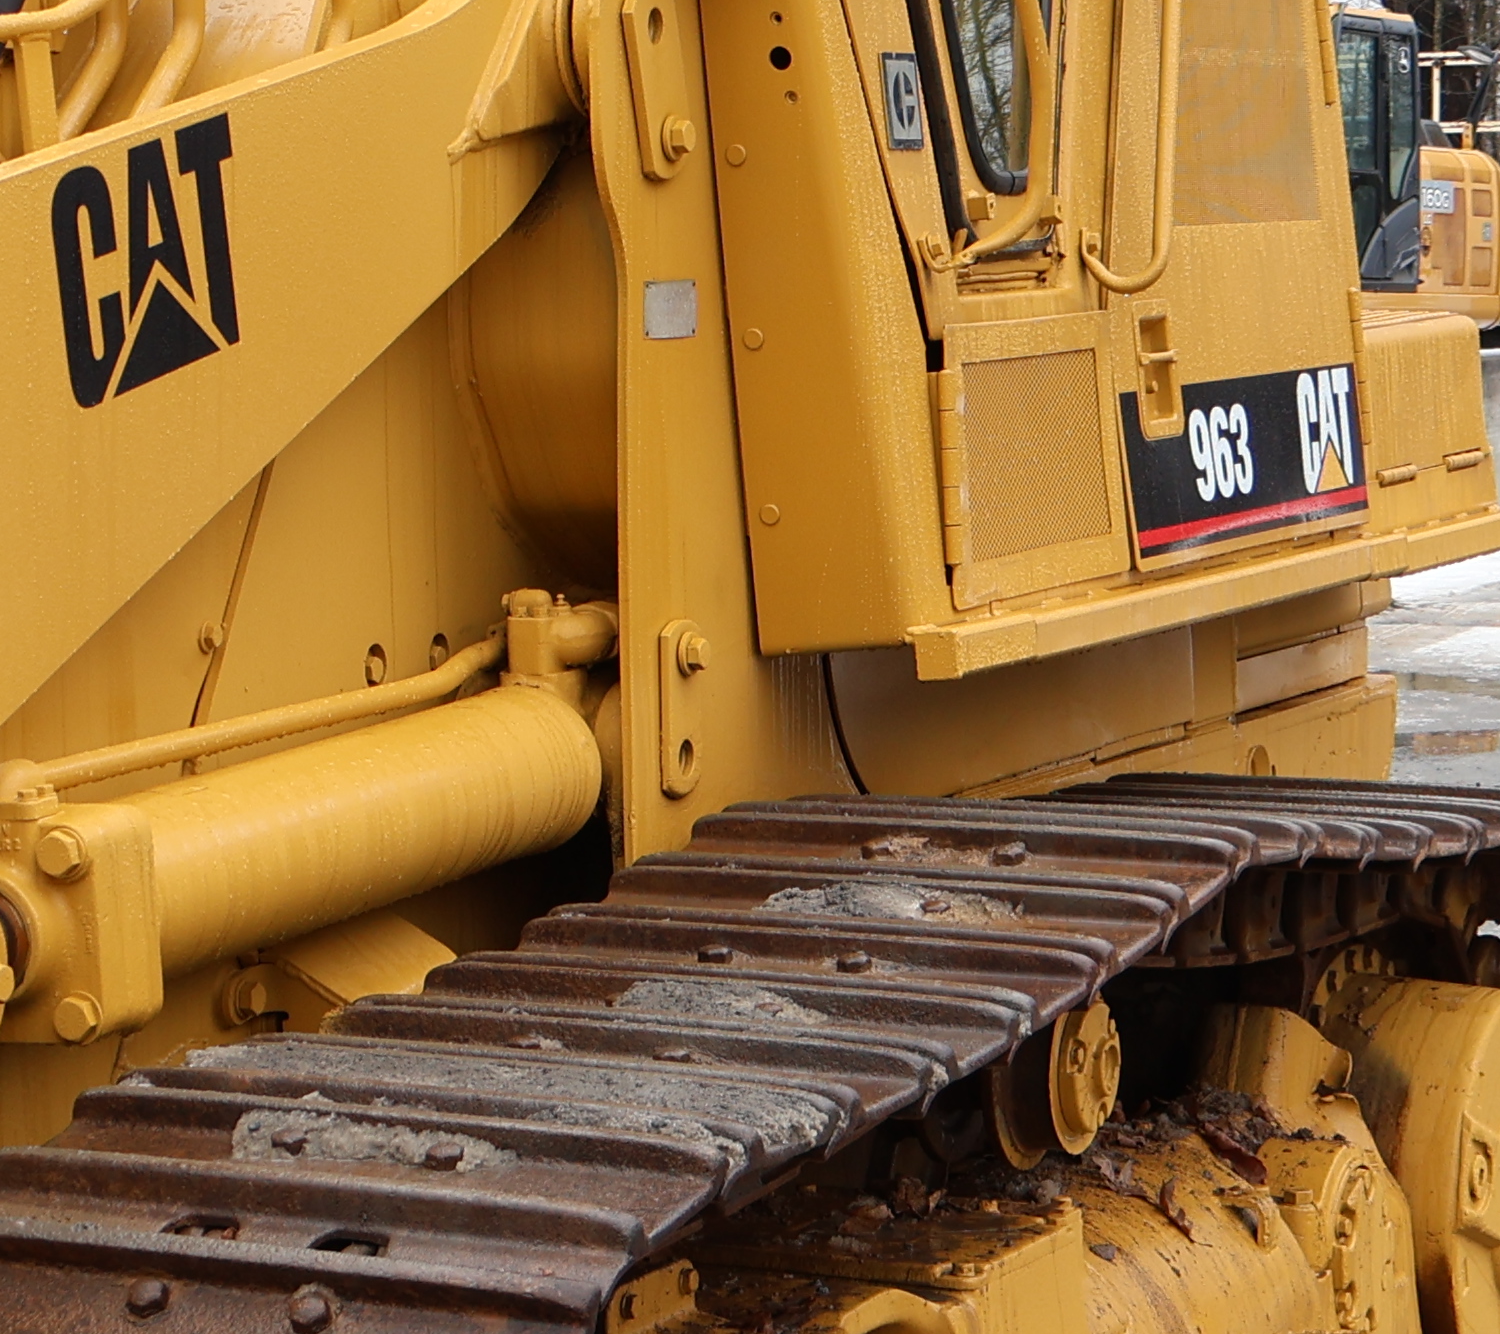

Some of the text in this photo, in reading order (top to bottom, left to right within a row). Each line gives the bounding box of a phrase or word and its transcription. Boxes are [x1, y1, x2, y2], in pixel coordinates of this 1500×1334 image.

[51, 112, 241, 409] CAT
[1188, 366, 1355, 502] 963 CAT
